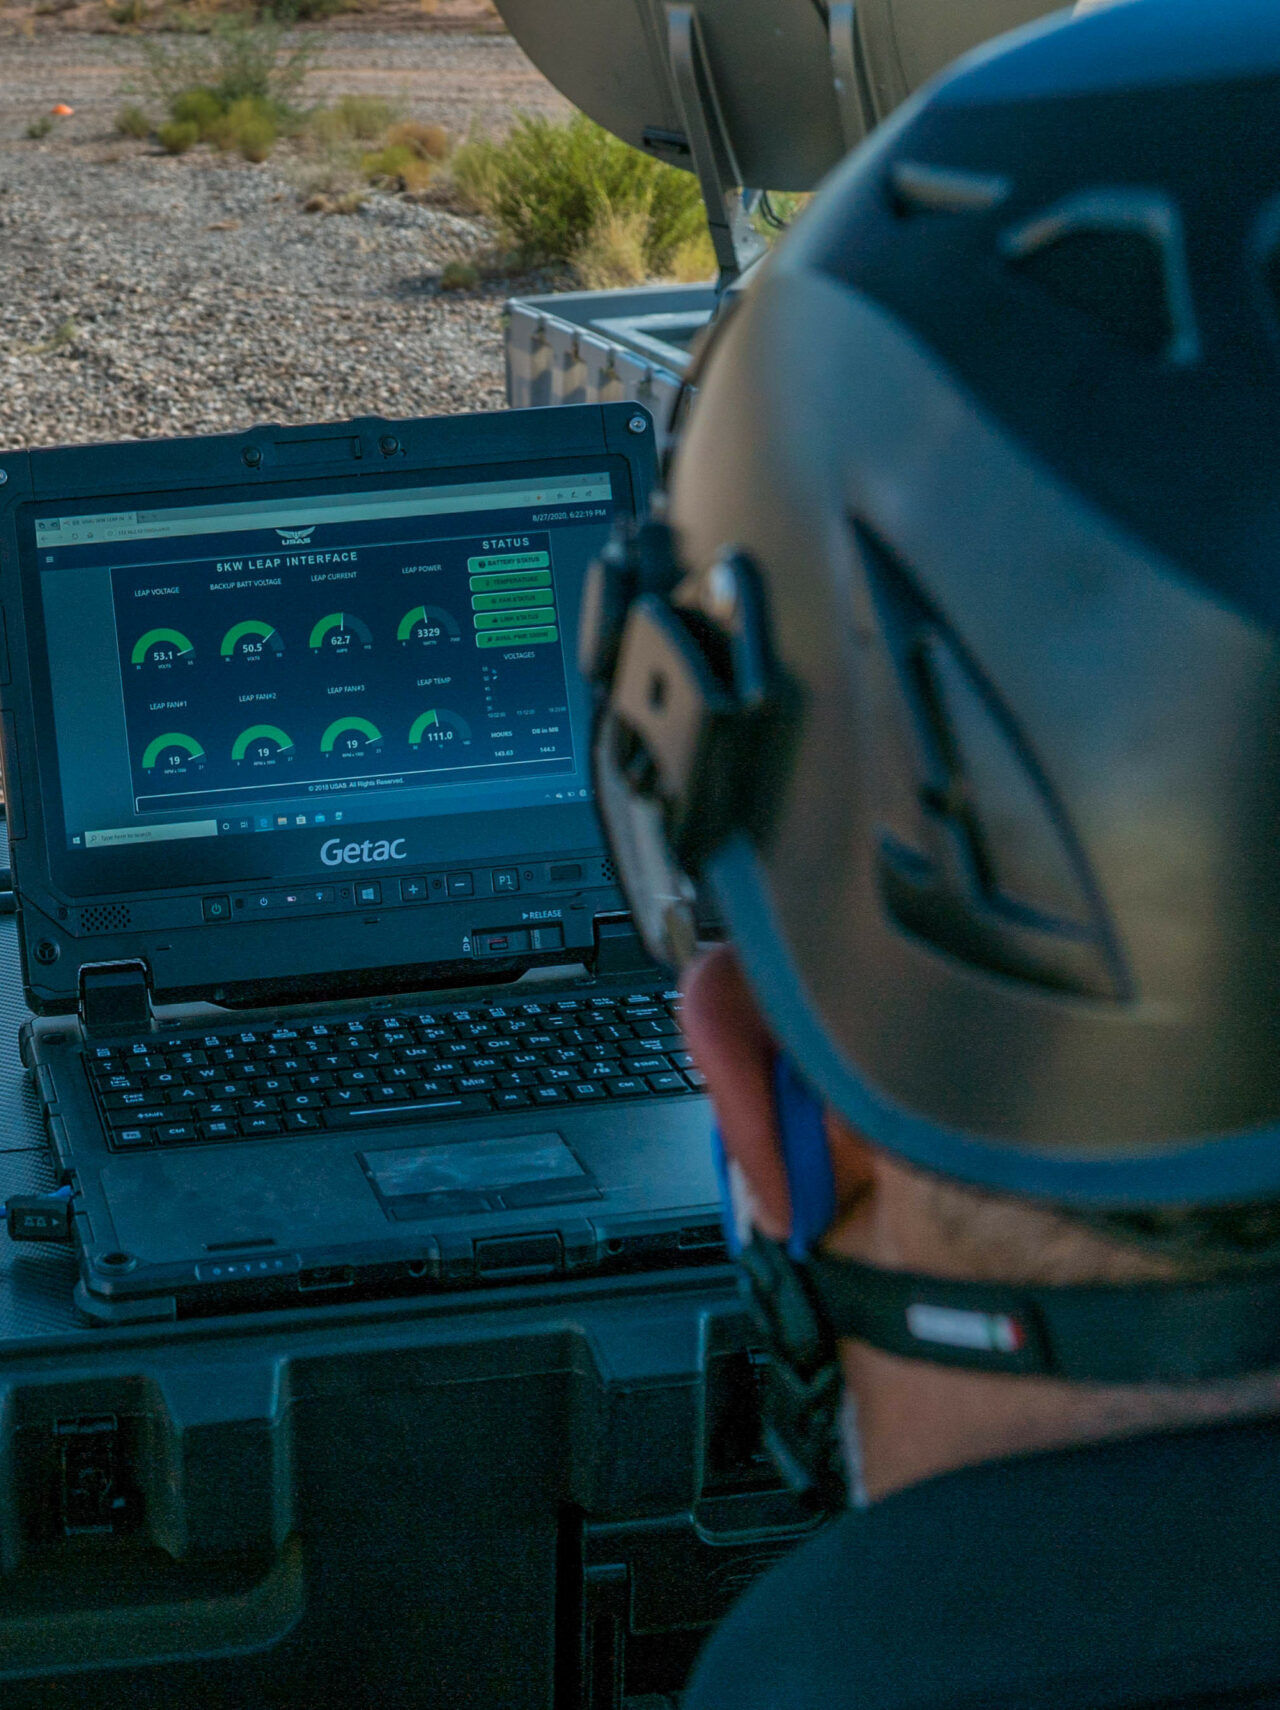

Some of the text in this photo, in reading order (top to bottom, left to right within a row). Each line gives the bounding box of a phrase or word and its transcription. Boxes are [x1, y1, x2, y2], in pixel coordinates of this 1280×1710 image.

[595, 508, 607, 516] PM
[282, 537, 311, 545] USAS
[482, 538, 530, 549] STATUS
[216, 552, 358, 572] 5KW LEAP INTERFACE
[488, 558, 515, 566] BATTERY
[418, 564, 442, 572] POWER
[327, 571, 357, 580] CURRENT
[209, 582, 235, 590] BACKUP
[253, 578, 282, 586] VOLTAGE
[493, 576, 538, 585] TEMPERATURE
[151, 586, 180, 595] VOLTAGE
[417, 628, 440, 638] 3329
[331, 636, 351, 645] 62.7
[242, 643, 263, 653] 50.5
[153, 651, 173, 661] 53.1
[504, 651, 535, 660] VOLTAGES
[150, 700, 187, 710] LEAP FAN#1
[428, 731, 453, 742] 111.0
[491, 730, 513, 738] HOURS
[346, 740, 358, 749] 19
[258, 748, 269, 757] 19
[169, 756, 180, 765] 19
[320, 838, 407, 866] Getac
[498, 875, 513, 887] P1
[529, 909, 562, 920] RELEASE
